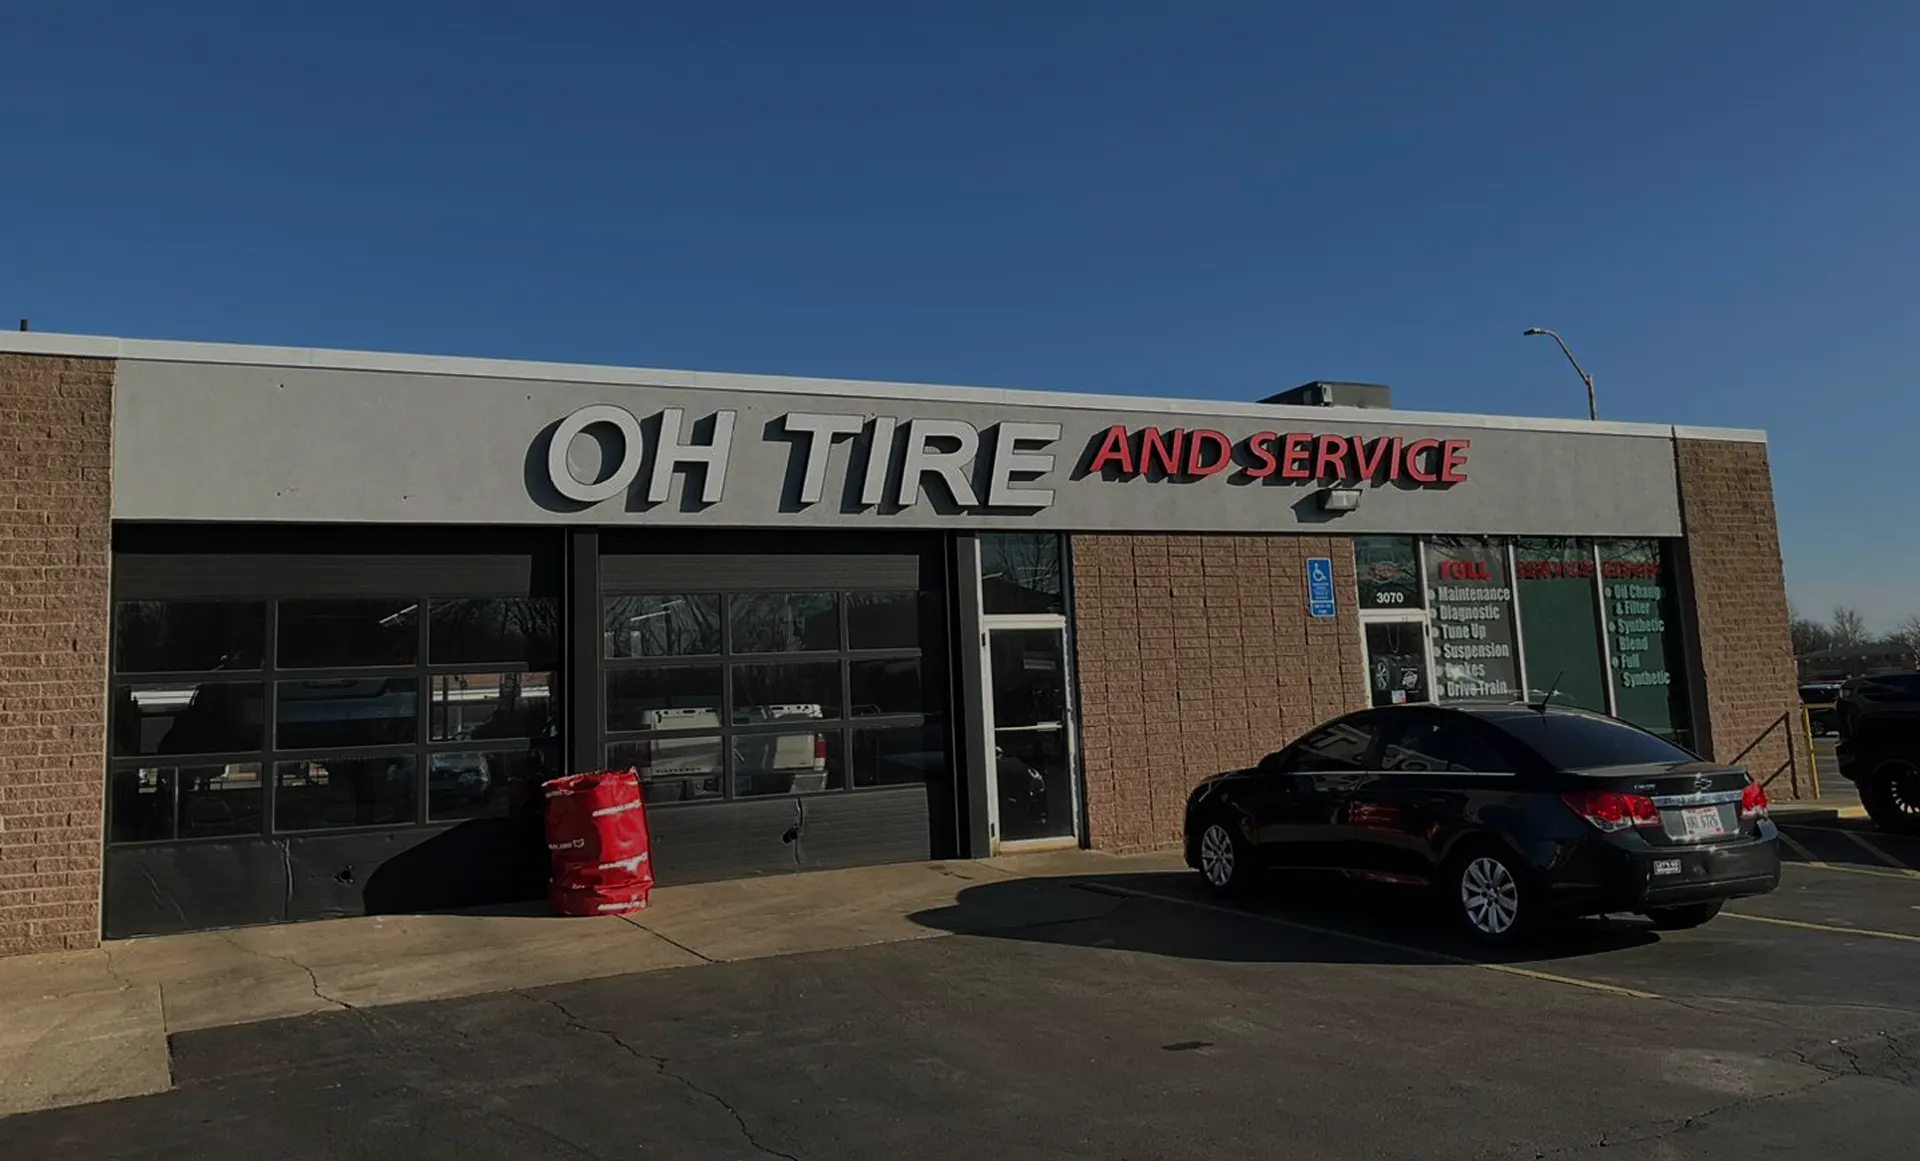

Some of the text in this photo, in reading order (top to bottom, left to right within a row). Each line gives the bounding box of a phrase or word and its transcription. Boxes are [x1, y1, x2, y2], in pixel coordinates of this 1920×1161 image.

[548, 404, 1471, 506] OH TIRE AND SERVICE
[1376, 592, 1404, 604] 3070
[1438, 586, 1511, 601] Maintenance
[1614, 584, 1628, 598] Oil
[1440, 604, 1500, 621] Diagnostic
[1615, 600, 1650, 615] & Filter
[1441, 623, 1487, 639] Tune Up
[1617, 617, 1665, 634] Synthetic
[1443, 642, 1509, 659] Suspension
[1619, 635, 1649, 650] Blend
[1621, 653, 1640, 668] Full
[1445, 661, 1486, 678] Bkes
[1623, 670, 1671, 688] Synthetic
[1447, 679, 1508, 697] Drive Train
